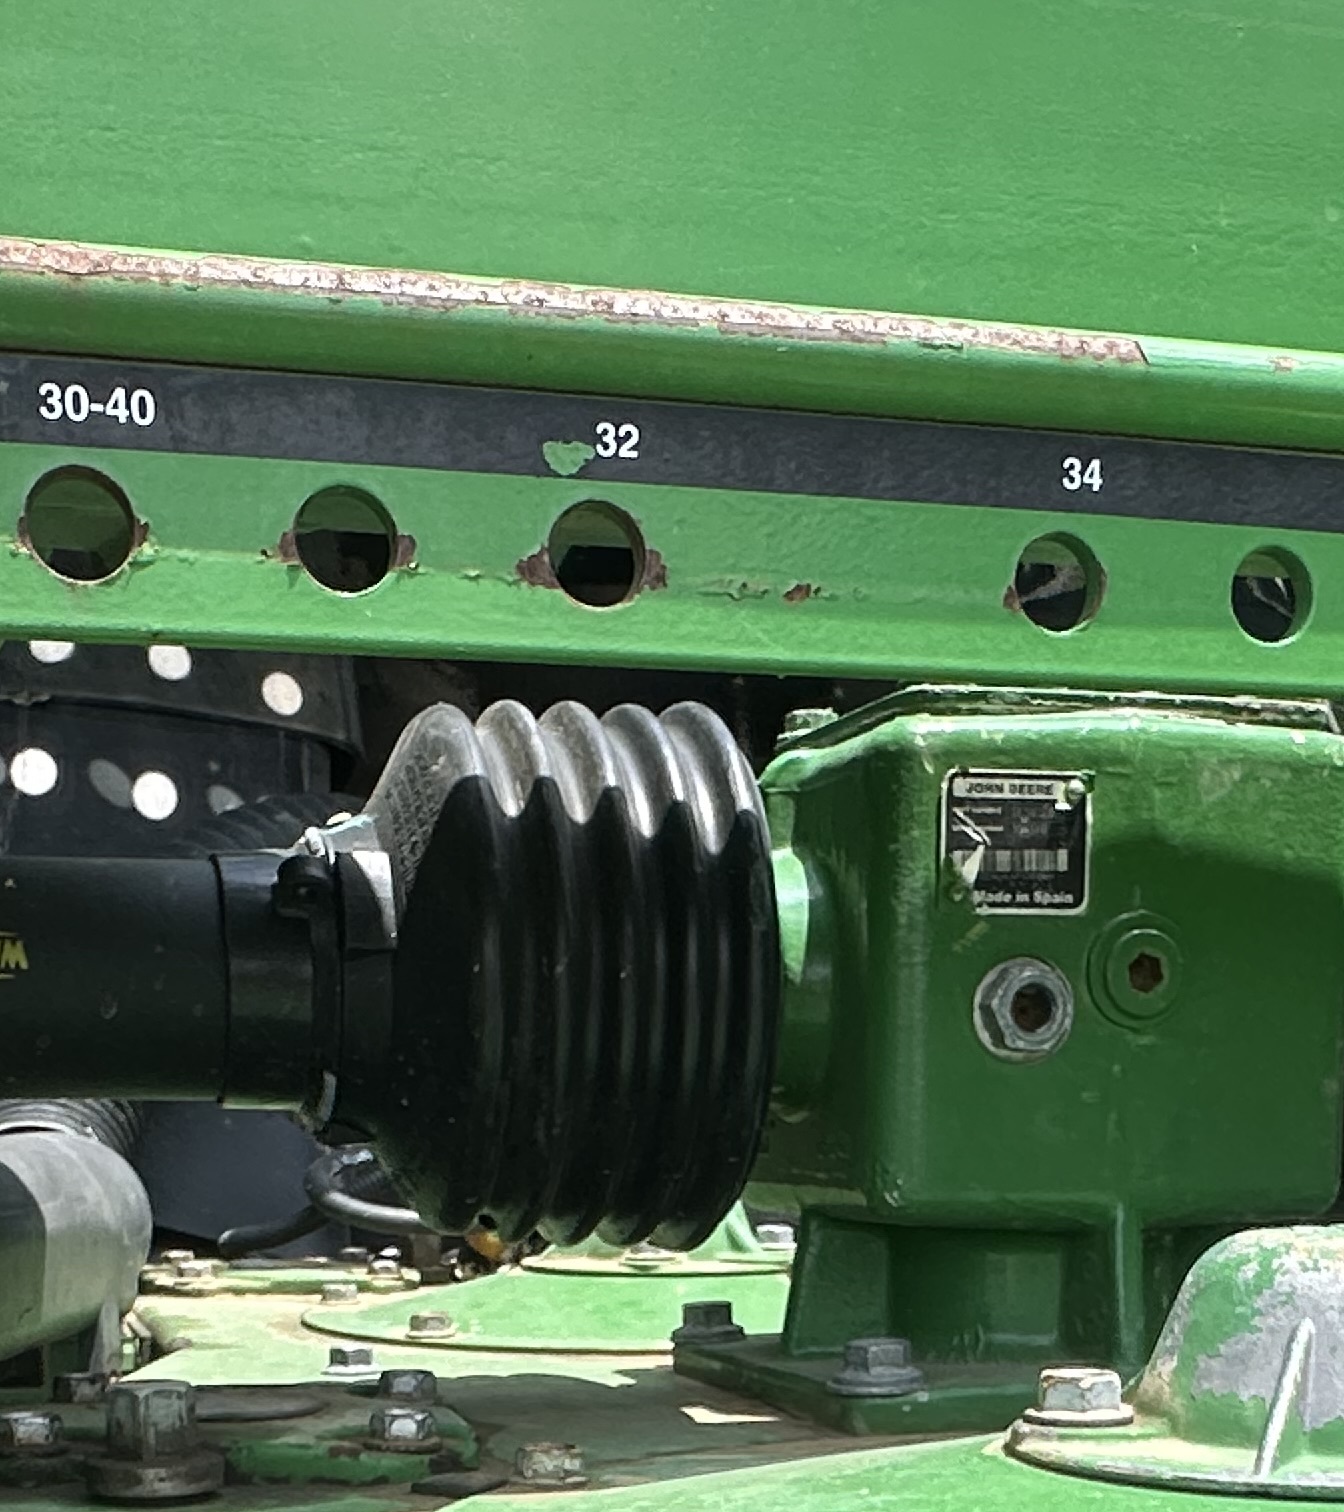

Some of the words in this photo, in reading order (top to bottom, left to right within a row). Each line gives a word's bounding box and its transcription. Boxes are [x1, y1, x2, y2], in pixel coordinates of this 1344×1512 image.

[38, 382, 156, 427] 30-40
[595, 422, 640, 459] 32
[1061, 456, 1104, 492] 34
[965, 781, 1005, 795] JOHN
[1008, 782, 1055, 796] DEERE
[973, 890, 1012, 904] Made
[1014, 891, 1030, 903] in
[1033, 890, 1074, 905] Spain
